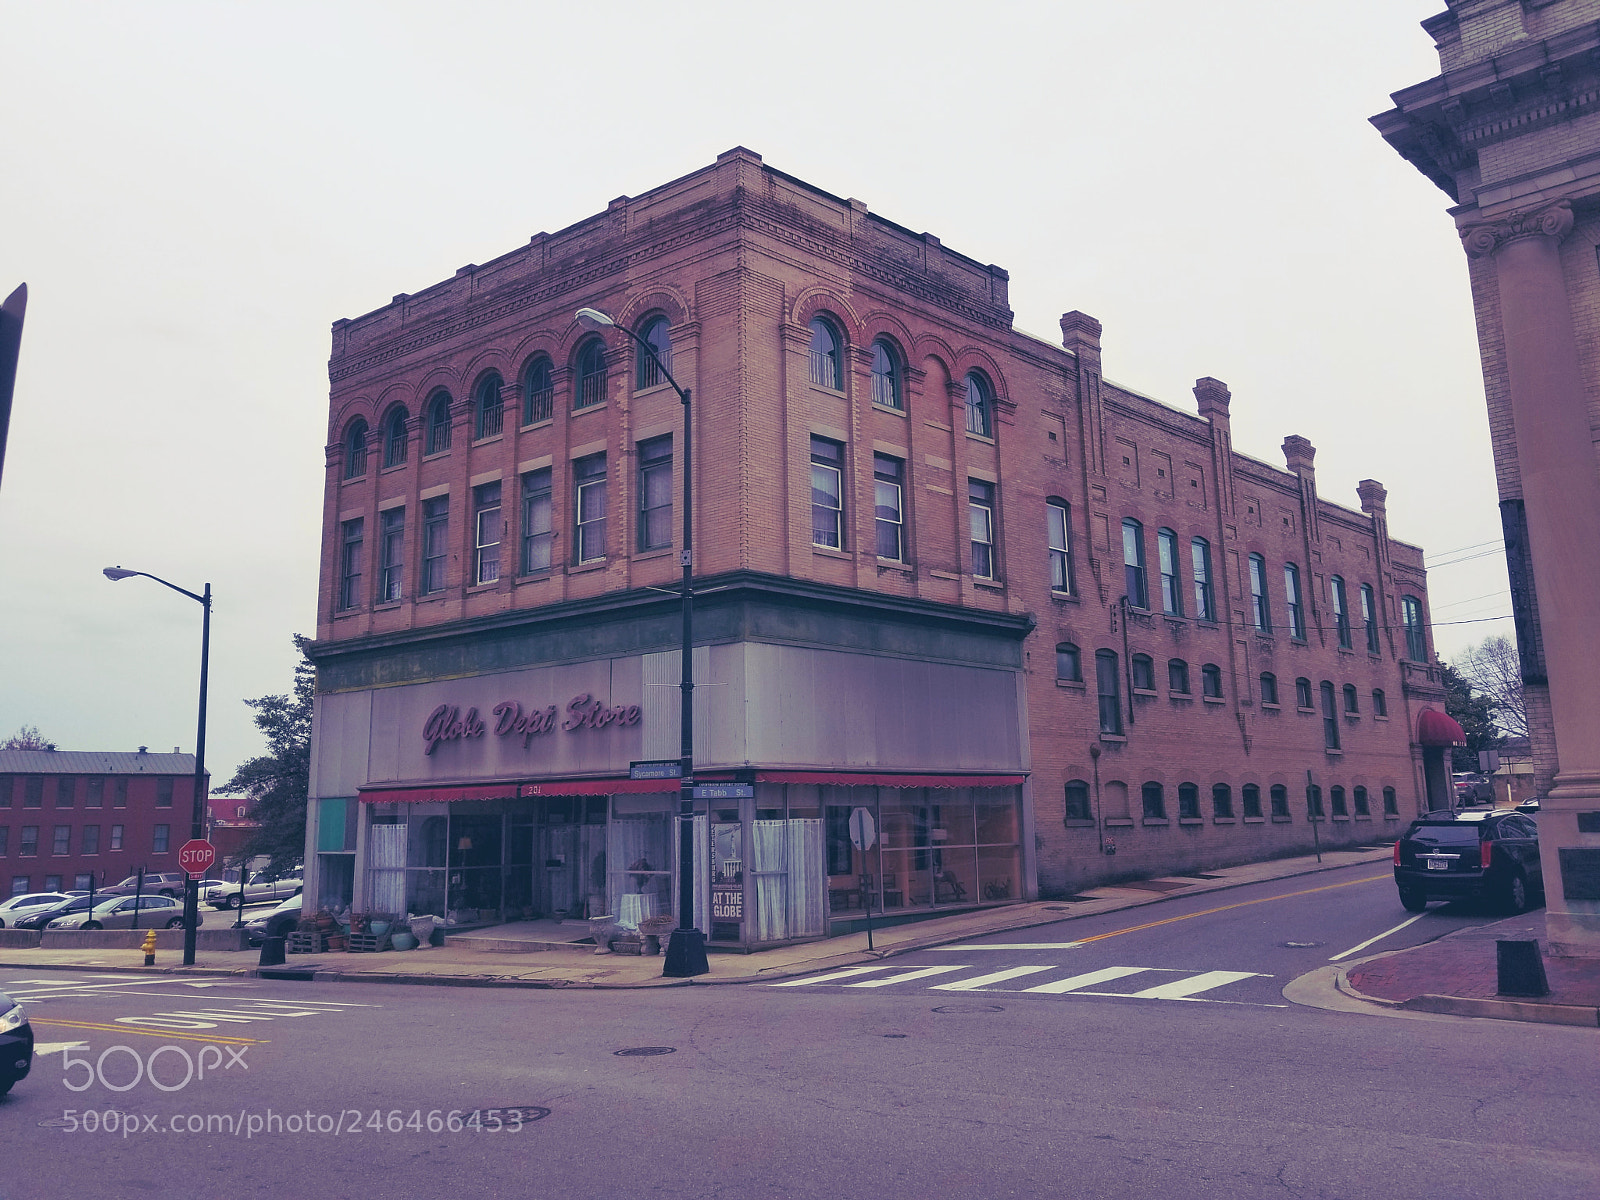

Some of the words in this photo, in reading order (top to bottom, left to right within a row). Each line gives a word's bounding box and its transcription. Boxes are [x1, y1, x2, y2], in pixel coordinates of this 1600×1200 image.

[422, 704, 485, 756] Globe
[493, 700, 556, 749] Dept
[561, 693, 640, 731] Store
[634, 770, 665, 778] Sycamore
[528, 785, 541, 795] 201
[701, 789, 707, 797] E
[709, 789, 727, 797] Tabb
[182, 849, 212, 863] STOP
[712, 892, 723, 904] AT
[725, 892, 742, 904] THE
[713, 905, 742, 918] GLOBE
[114, 1003, 344, 1029] ONLY
